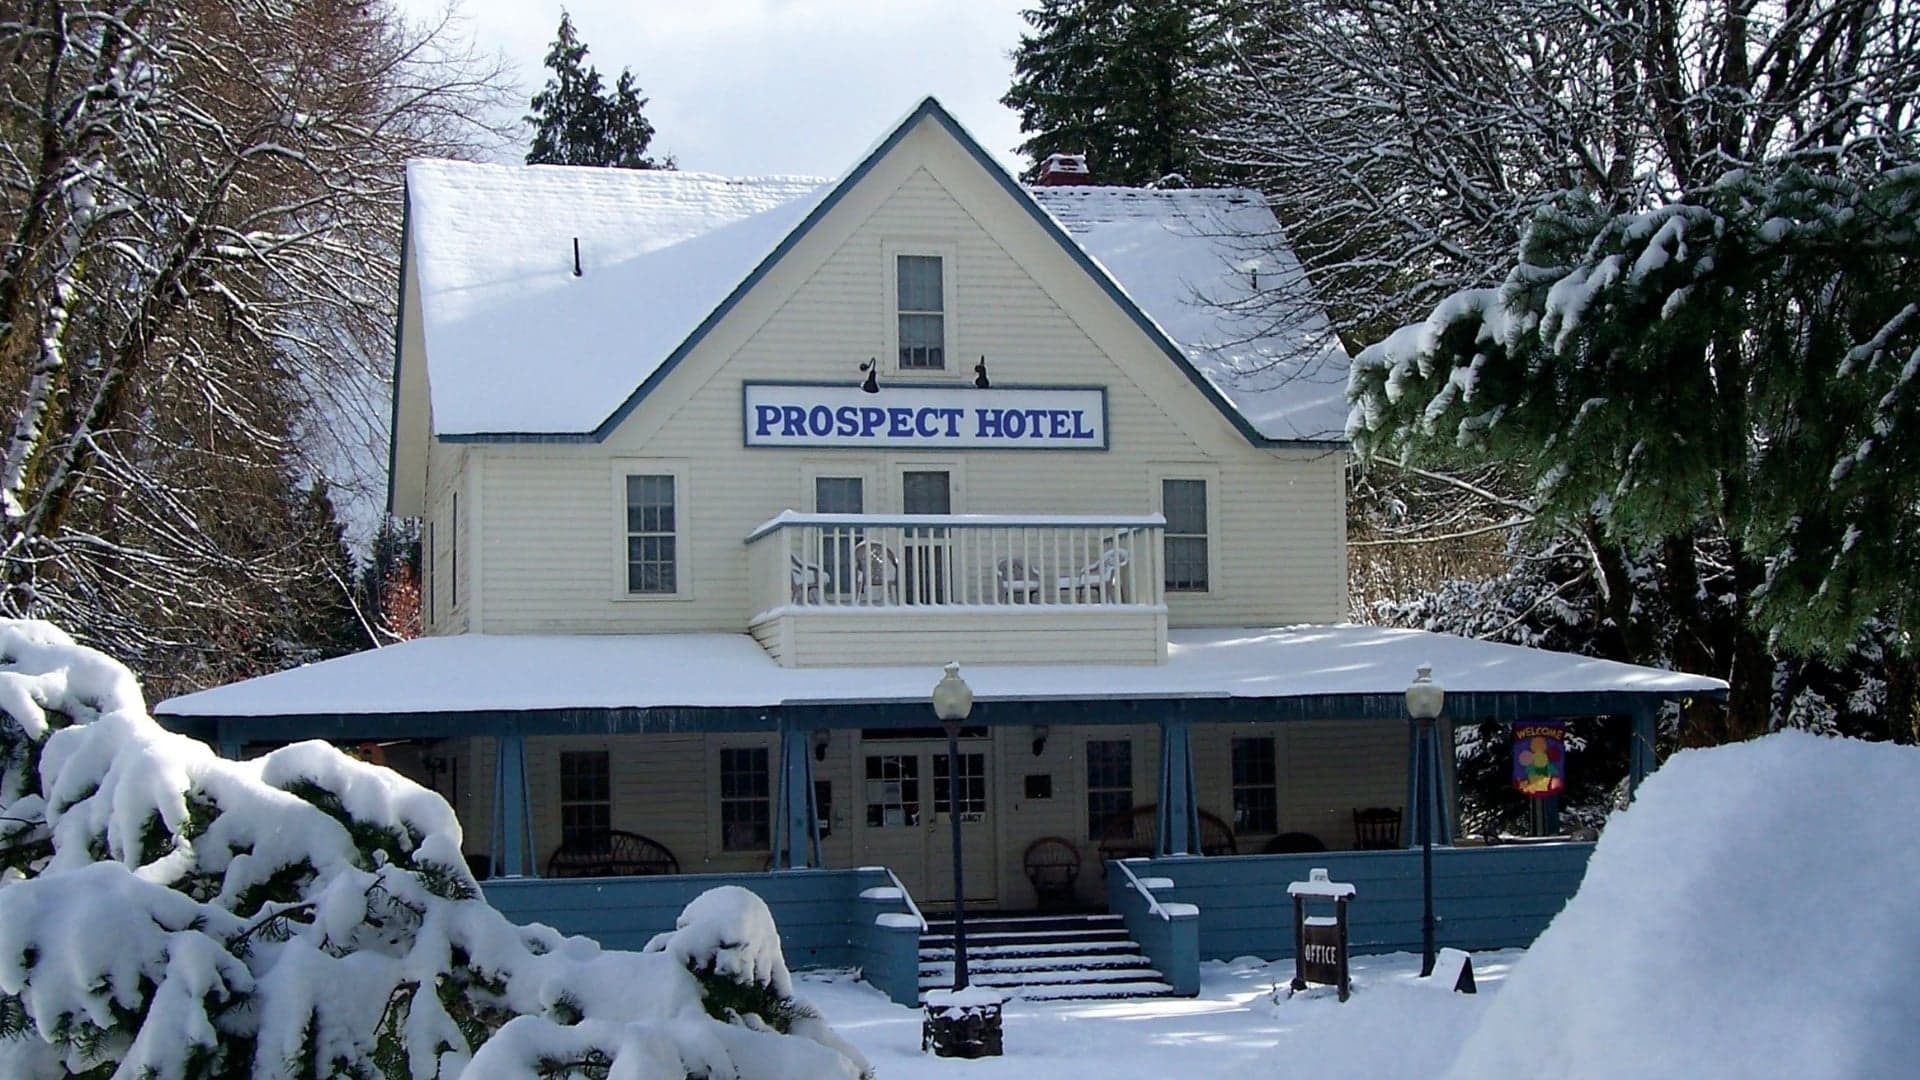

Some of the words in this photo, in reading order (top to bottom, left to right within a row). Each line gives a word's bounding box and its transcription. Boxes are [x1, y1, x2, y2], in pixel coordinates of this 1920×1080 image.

[755, 405, 964, 437] PROSPECT
[975, 409, 1095, 438] HOTEL
[1517, 727, 1564, 739] WELCOME
[1305, 944, 1337, 964] OFFICE
